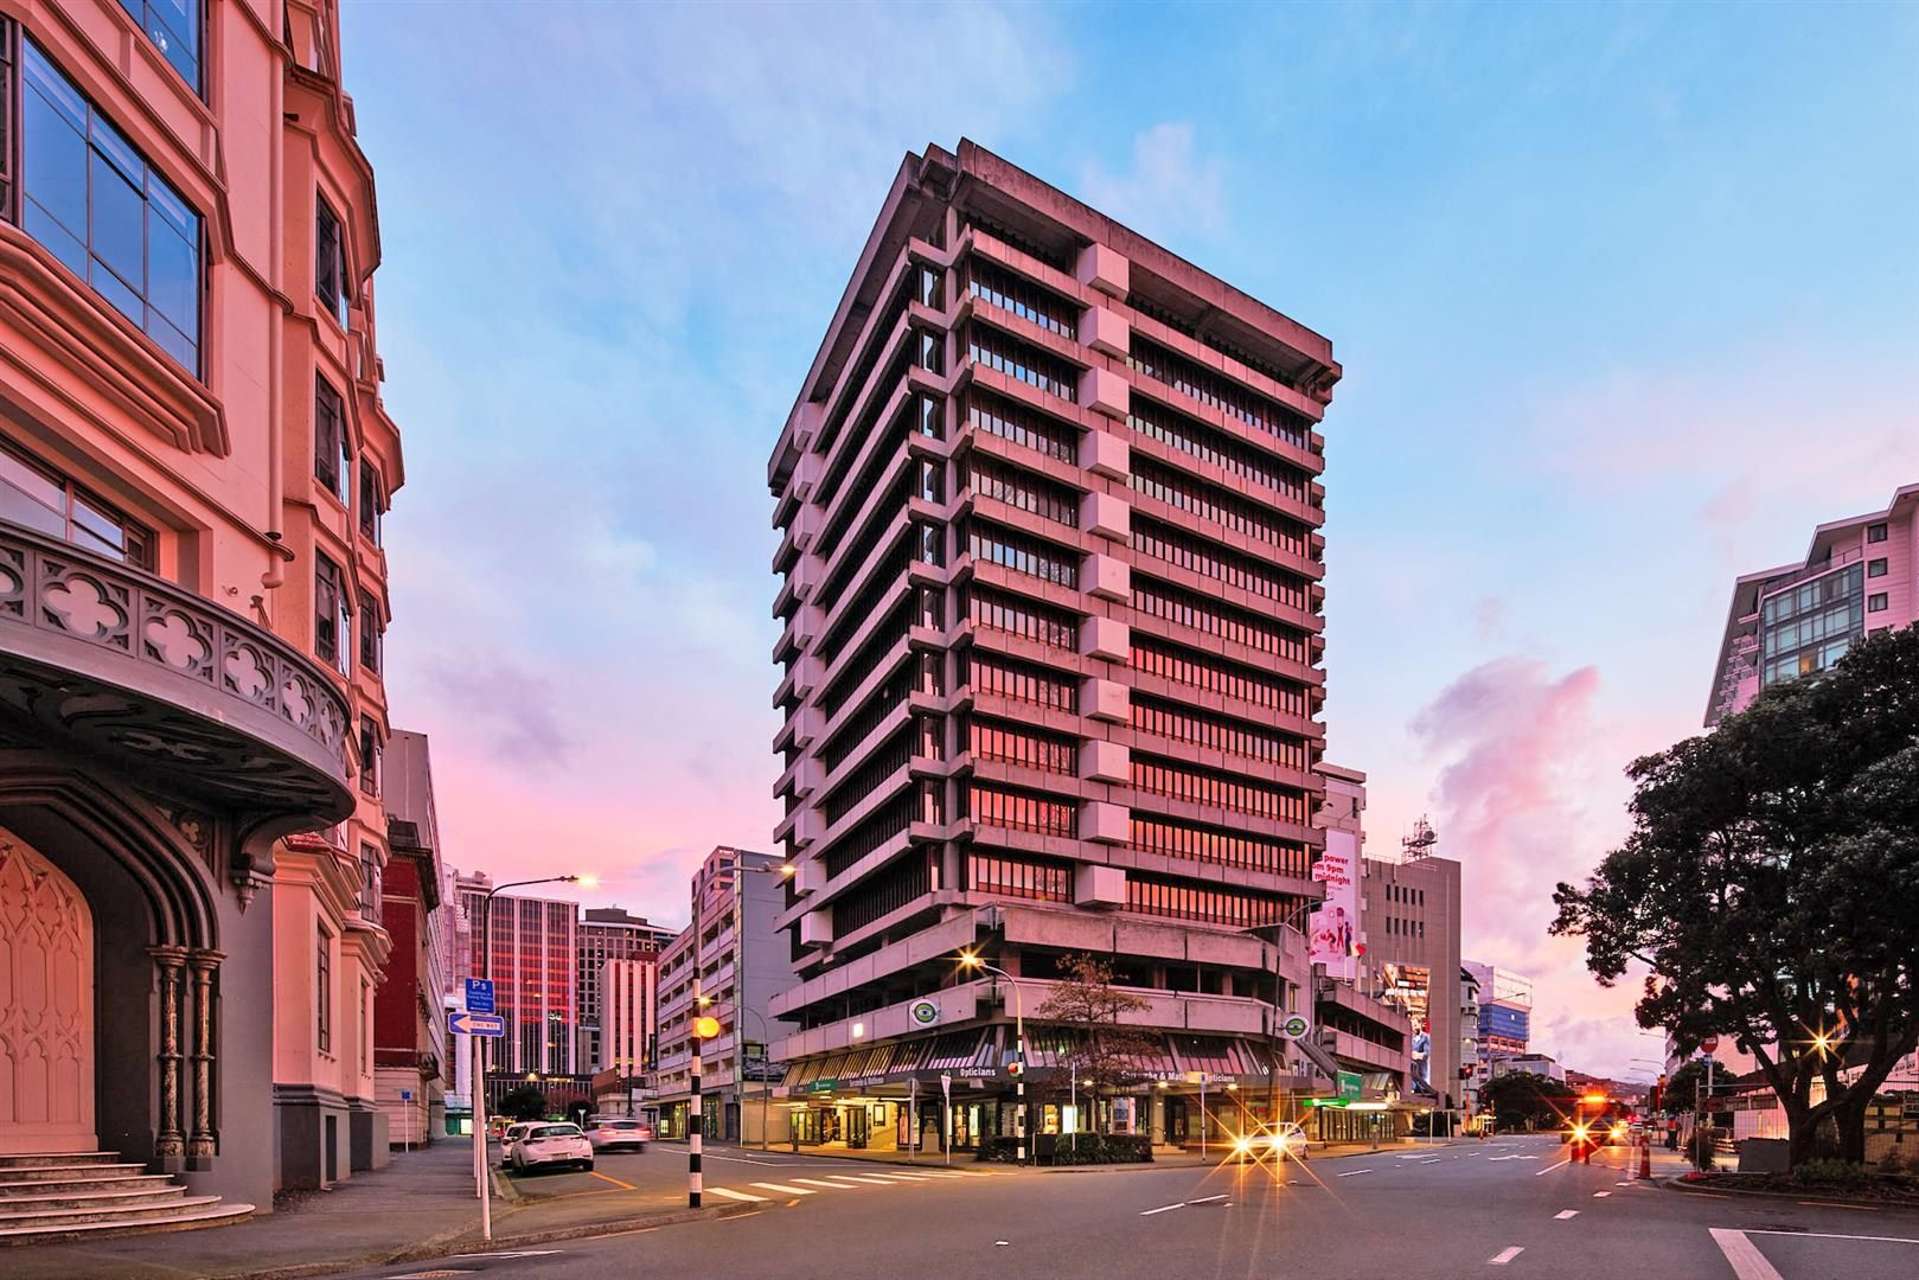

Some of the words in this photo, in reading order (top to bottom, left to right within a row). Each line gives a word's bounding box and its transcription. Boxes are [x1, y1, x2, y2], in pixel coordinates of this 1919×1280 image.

[1324, 855, 1349, 864] power
[1326, 864, 1344, 873] 9pm
[1315, 872, 1350, 885] midnight
[960, 1068, 996, 1078] Opticians
